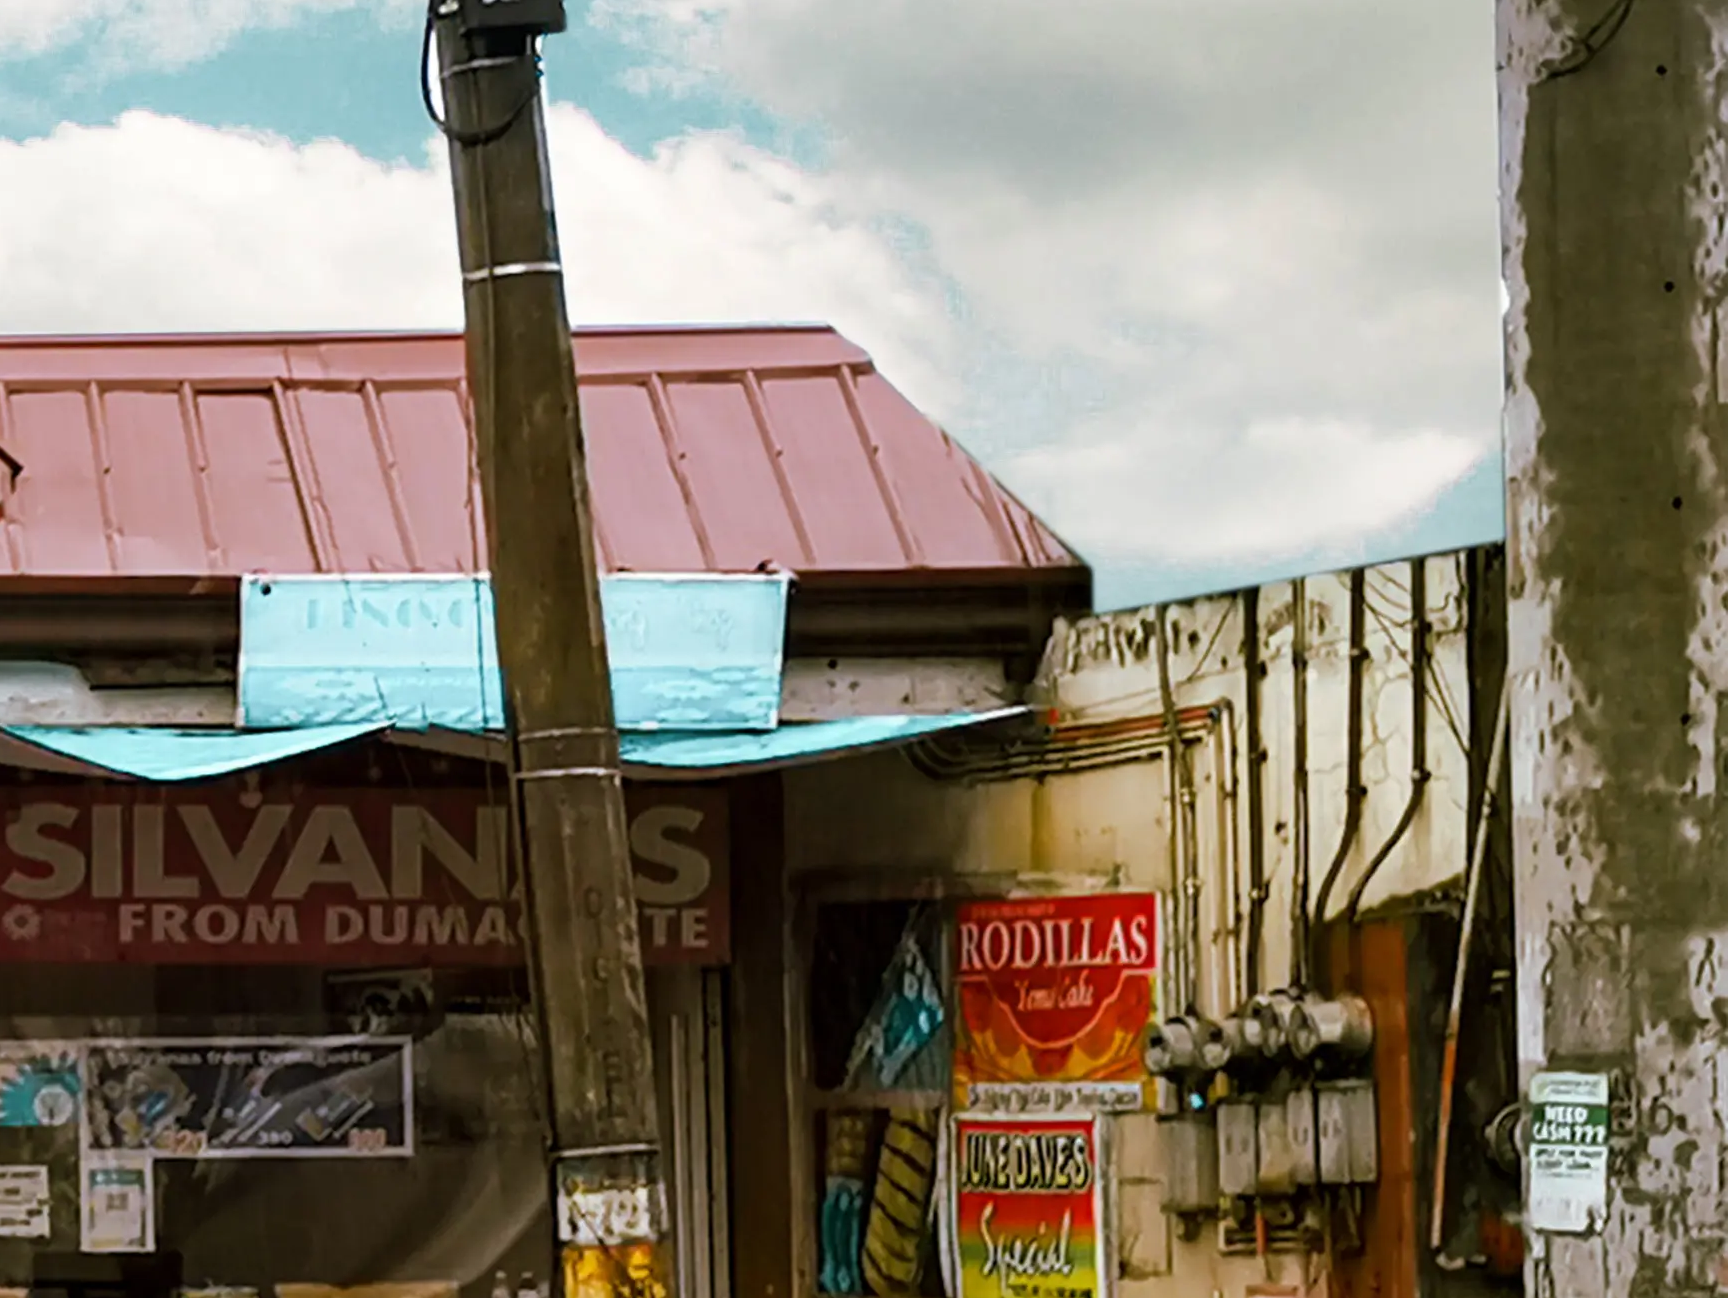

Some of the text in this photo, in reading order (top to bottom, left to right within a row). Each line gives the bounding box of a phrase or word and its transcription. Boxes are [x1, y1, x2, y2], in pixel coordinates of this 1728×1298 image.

[1, 801, 712, 905] SILVANS
[117, 905, 711, 950] FROM DUMATE
[960, 914, 1149, 972] RODILLAS
